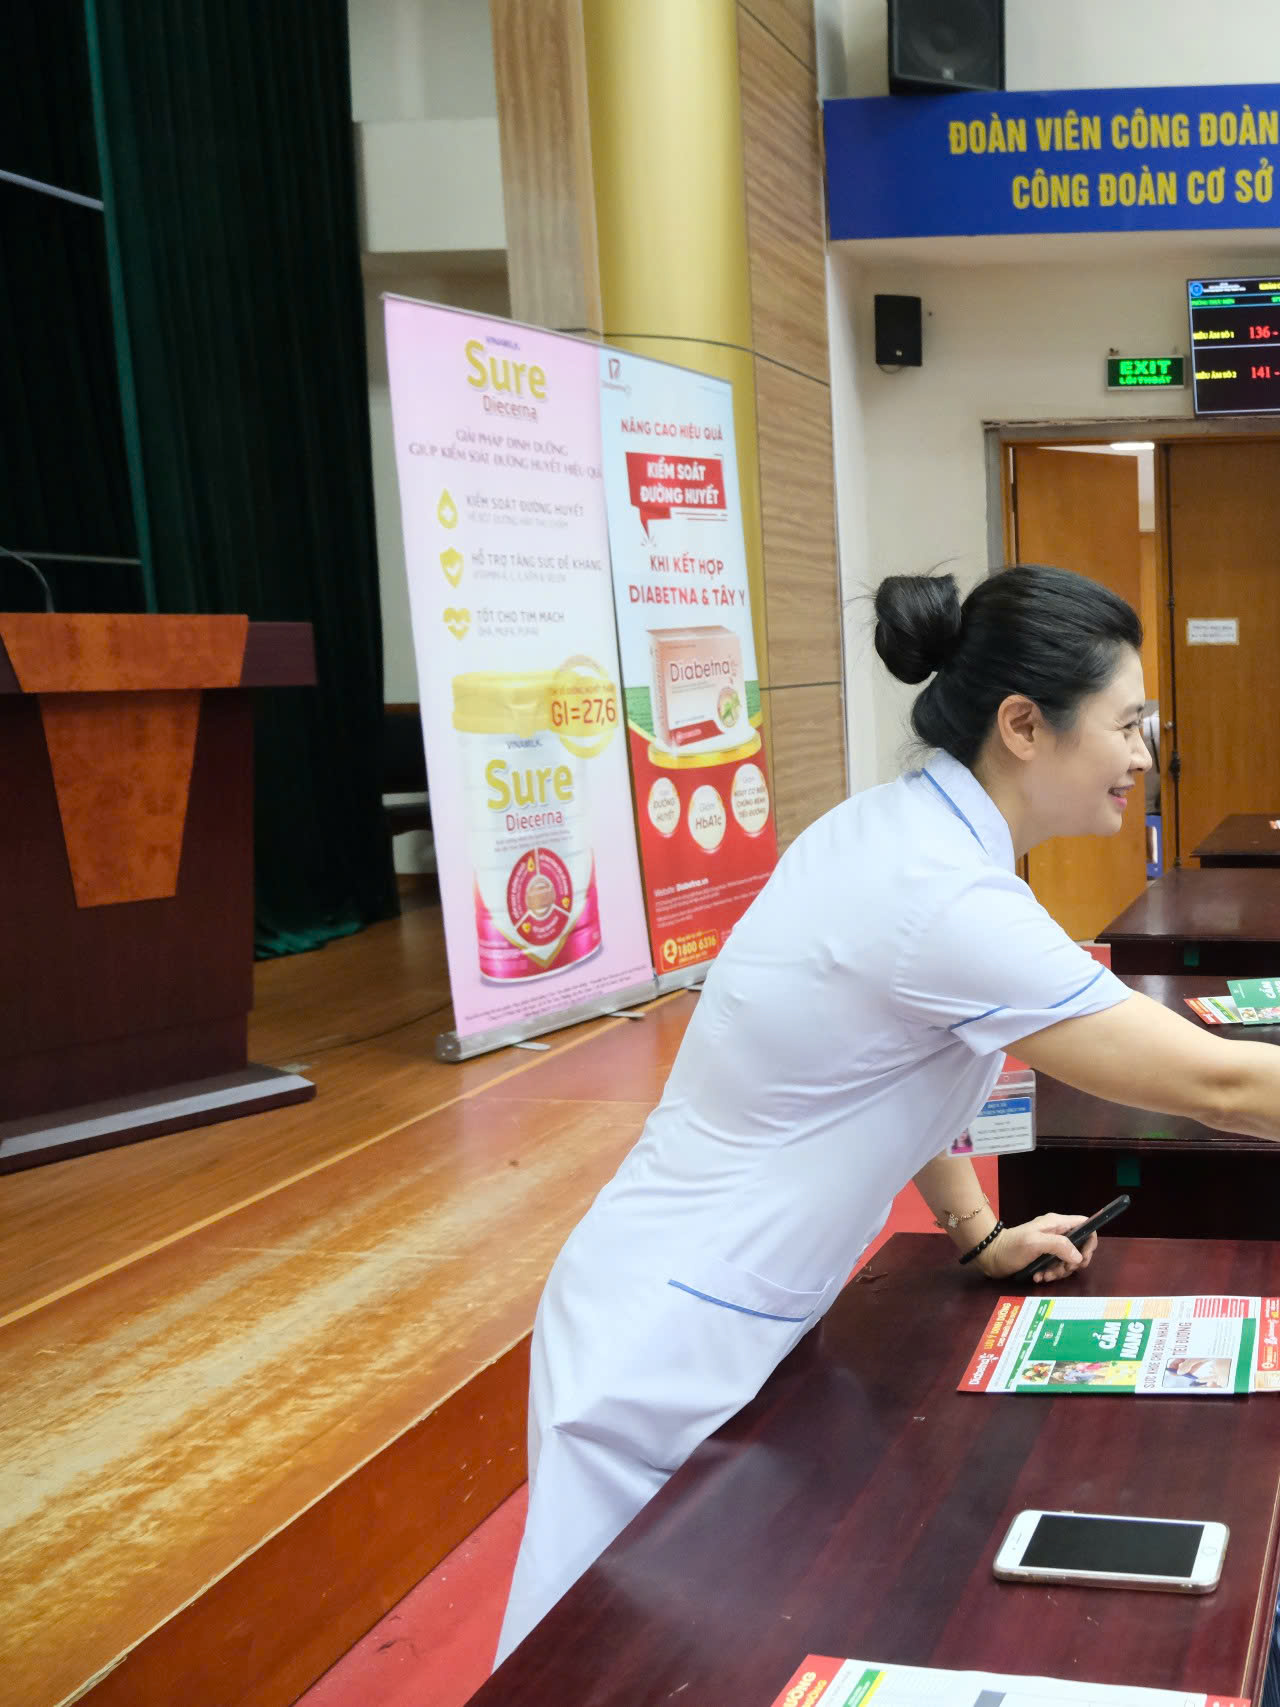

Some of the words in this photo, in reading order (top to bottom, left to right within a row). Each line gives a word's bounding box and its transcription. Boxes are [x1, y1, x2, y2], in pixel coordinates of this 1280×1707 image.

[949, 111, 1027, 155] ĐOÀN
[1036, 109, 1101, 151] VIÊN
[1111, 108, 1190, 148] CÔNG
[1199, 103, 1278, 146] ĐOÀN
[1012, 167, 1090, 208] CÔNG
[1098, 164, 1177, 206] ĐOÀN
[1187, 167, 1225, 204] CƠ
[1235, 158, 1274, 203] SỞ
[1249, 326, 1270, 339] 136
[464, 339, 546, 400] Sure
[1120, 360, 1171, 375] EXIT
[1251, 366, 1270, 379] 141
[621, 416, 651, 435] NÂNG
[654, 422, 677, 438] CAO
[680, 421, 701, 443] HIỆU
[704, 422, 723, 441] QUẢ
[646, 456, 675, 480] KIỂM
[677, 461, 706, 481] SOÁT
[640, 483, 683, 503] ĐƯỜNG
[685, 484, 719, 505] HUYẾT
[651, 556, 669, 572] KHI
[674, 552, 695, 574] KẾT
[700, 559, 724, 579] HỢP
[628, 585, 698, 605] DIABETNA
[702, 590, 710, 605] &
[713, 585, 735, 606] TÂY
[670, 660, 730, 683] Diabetna
[485, 759, 574, 810] Sure
[506, 811, 564, 831] Diecerna
[696, 815, 722, 830] HbA1c
[1092, 1321, 1121, 1350] CẨM
[1120, 1321, 1145, 1358] NANG
[783, 1672, 817, 1707] ƯỠNG
